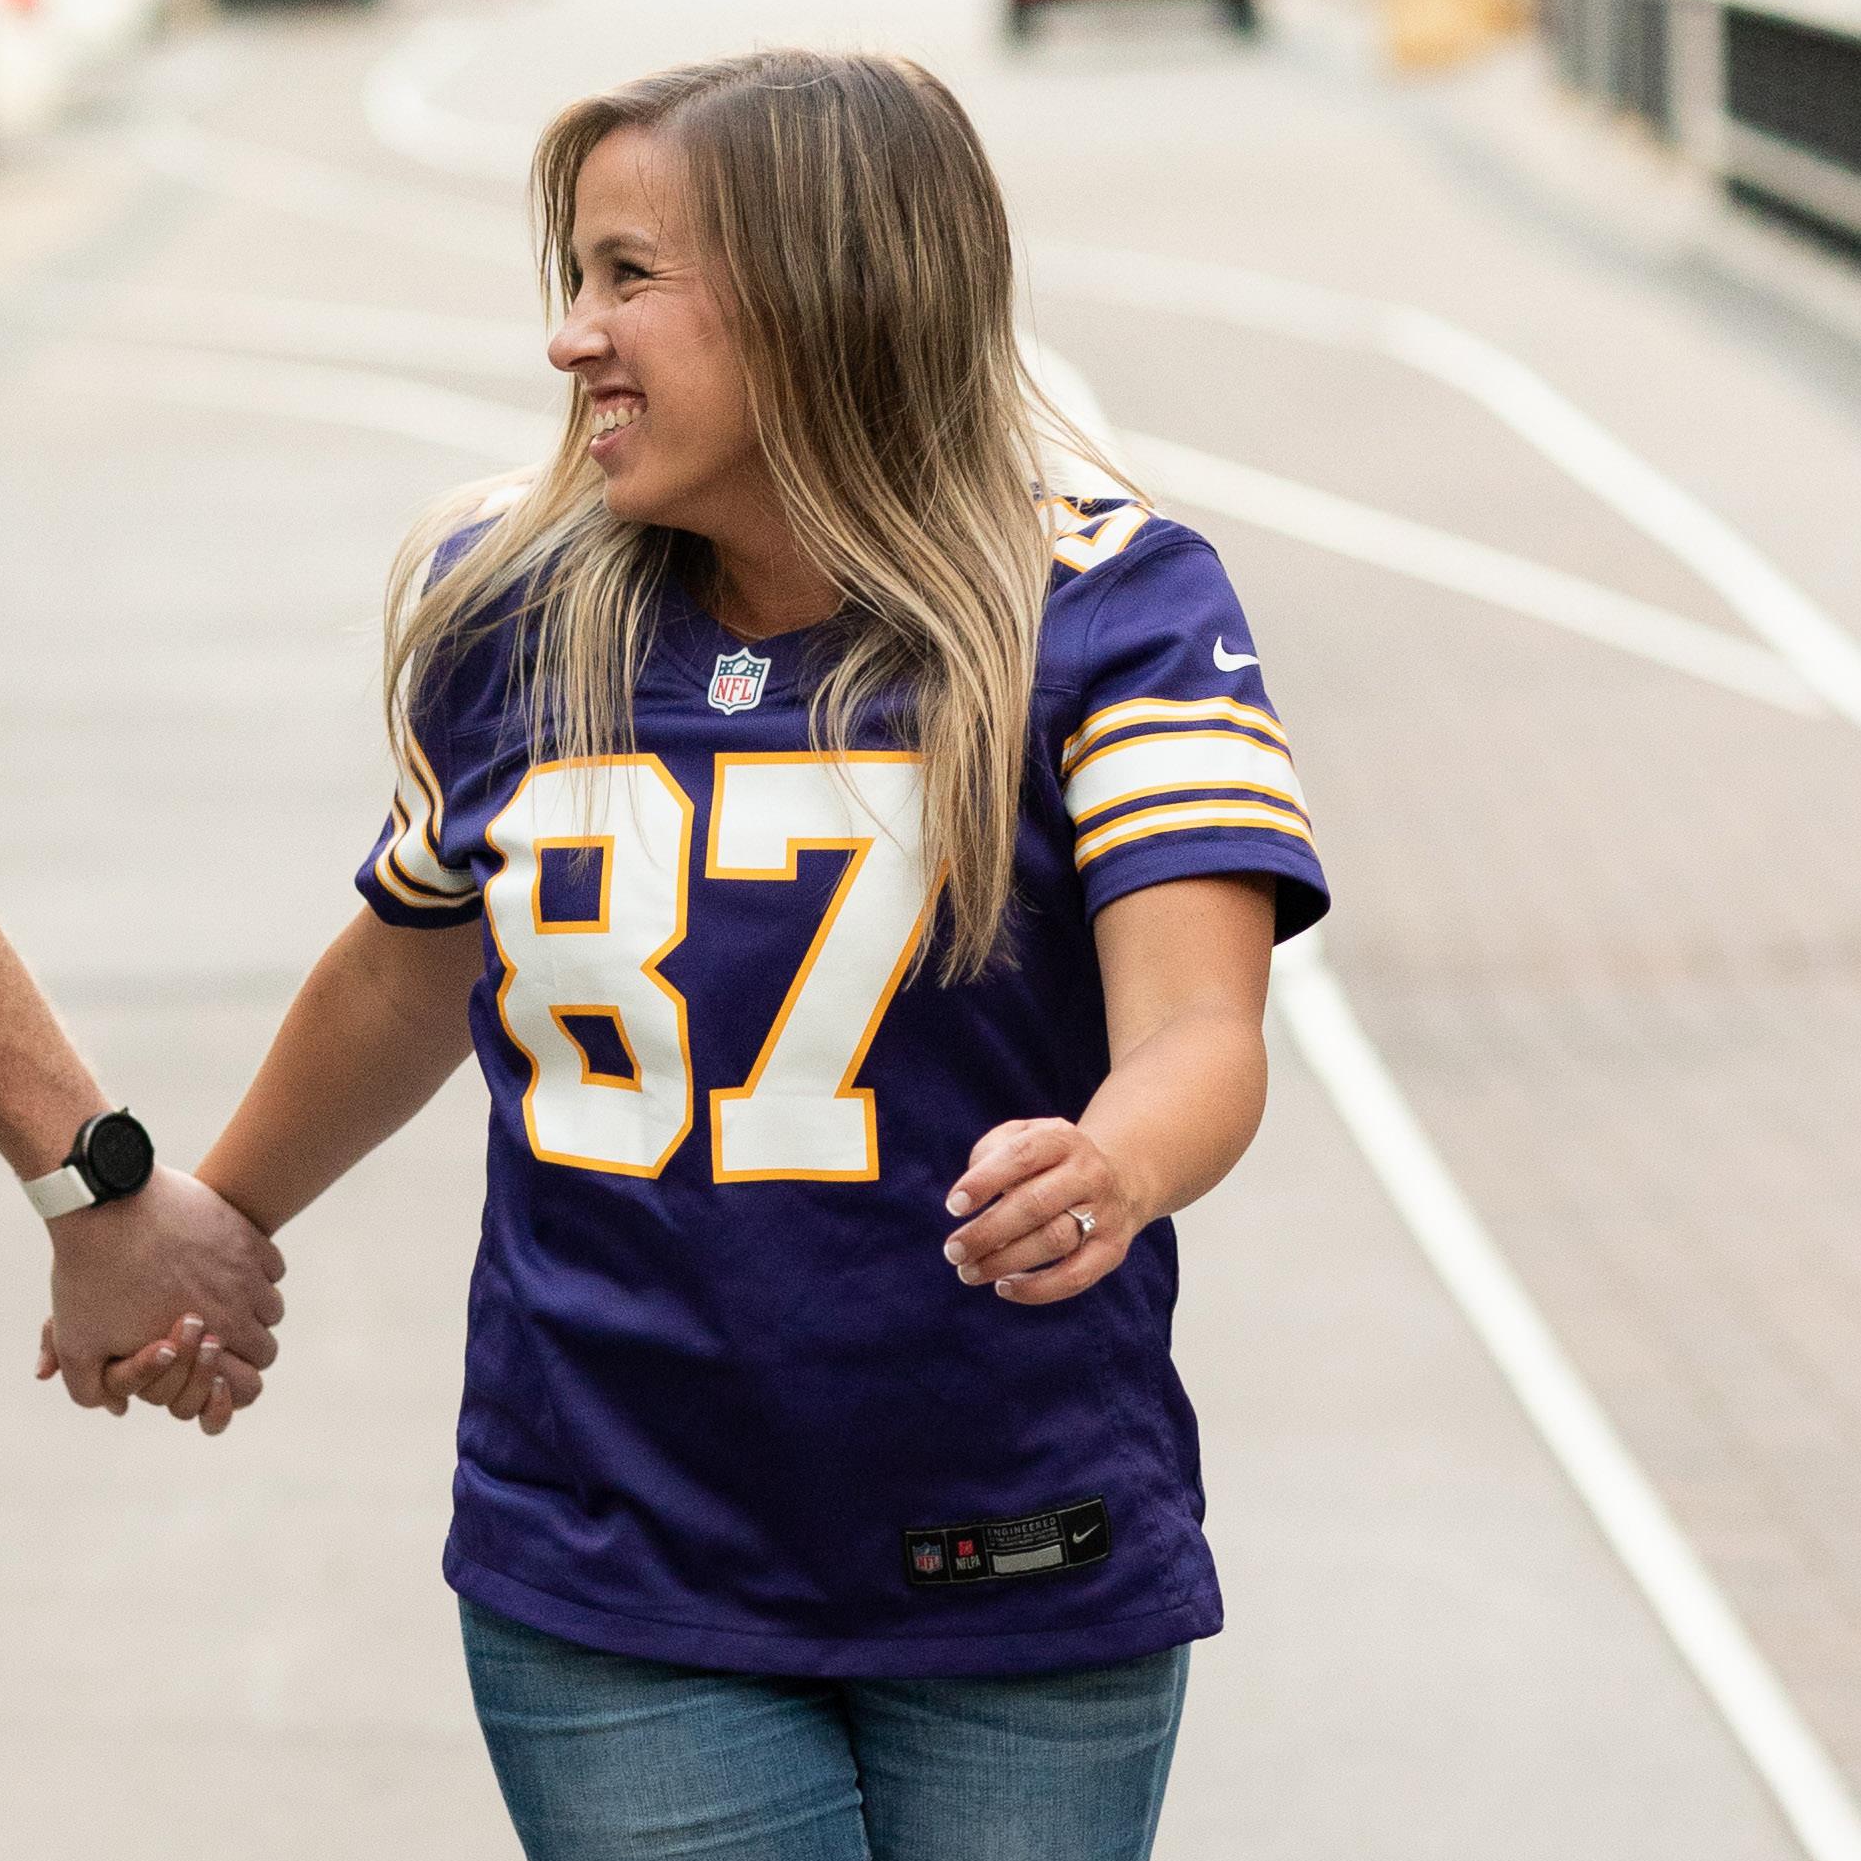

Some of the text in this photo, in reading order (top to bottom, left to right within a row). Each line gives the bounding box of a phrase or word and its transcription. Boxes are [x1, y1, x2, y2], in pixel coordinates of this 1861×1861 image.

[715, 676, 752, 703] NFL
[485, 749, 952, 1185] 87
[955, 1554, 982, 1571] NFLPA
